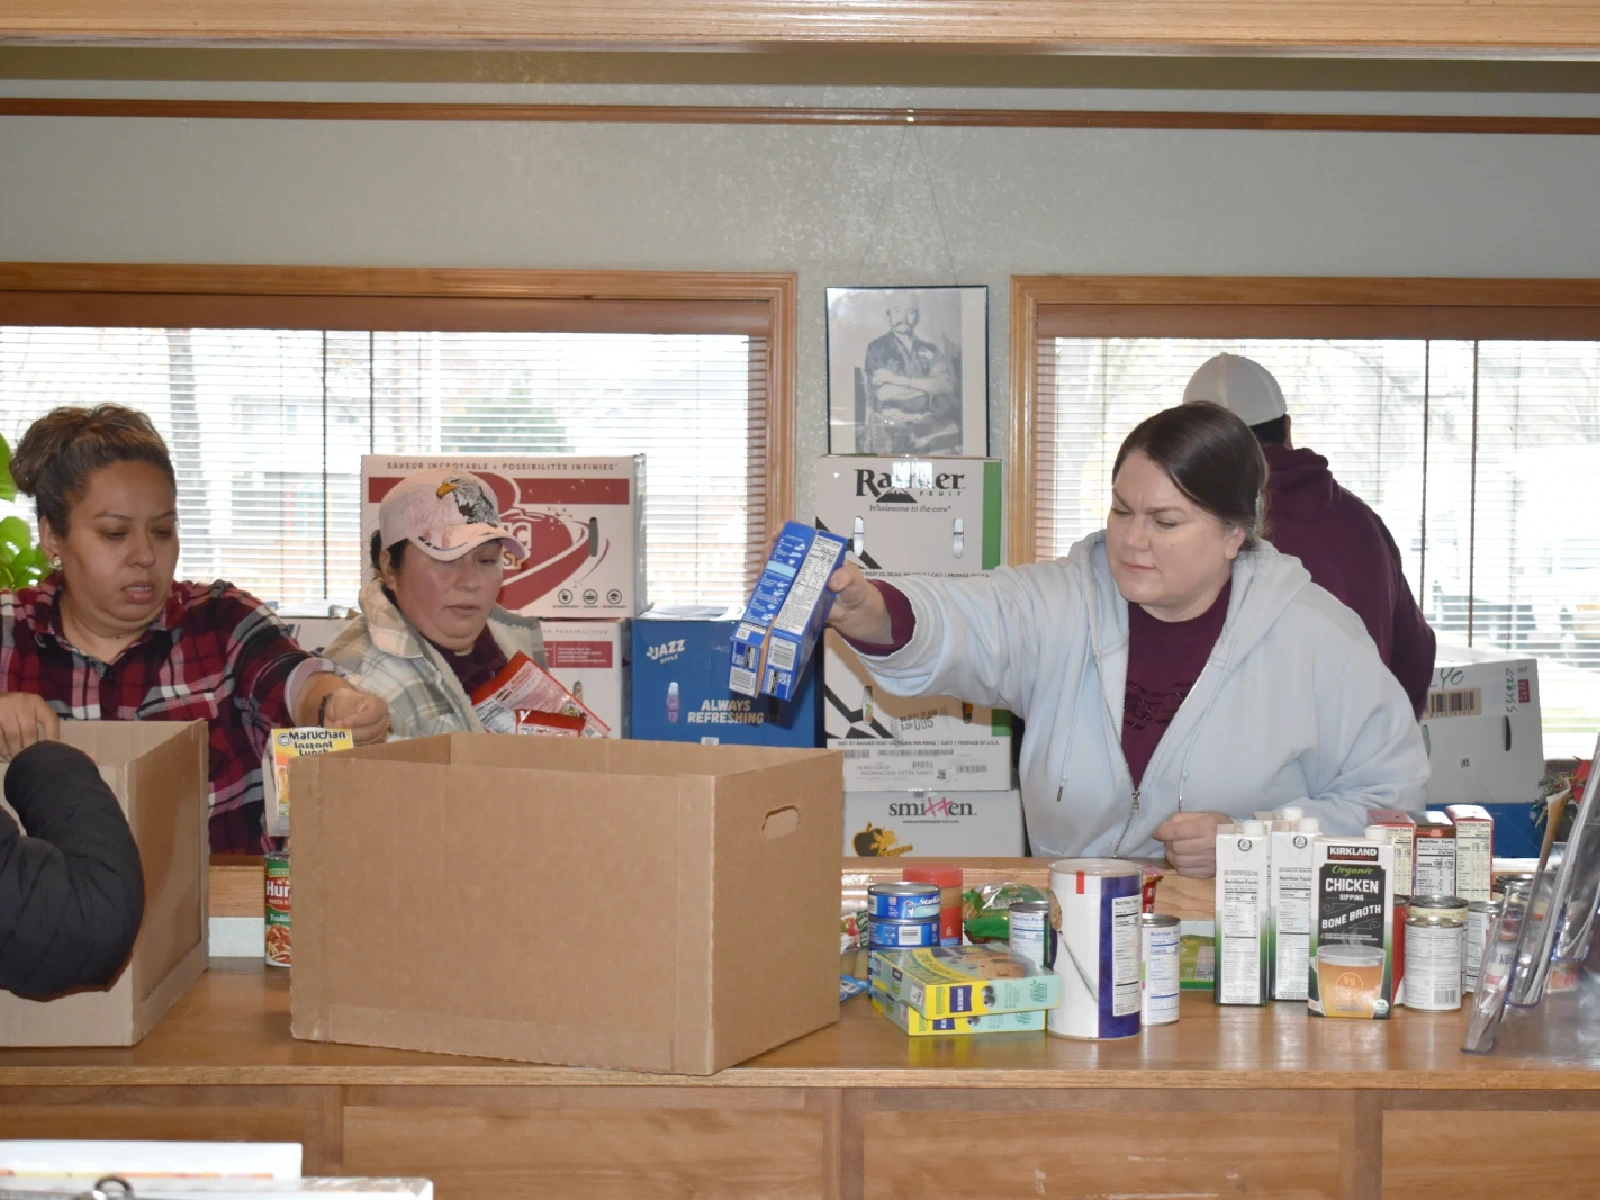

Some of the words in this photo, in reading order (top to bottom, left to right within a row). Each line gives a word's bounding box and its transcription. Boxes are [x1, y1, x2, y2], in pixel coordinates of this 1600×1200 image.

[855, 469, 966, 498] Raer
[869, 504, 910, 513] Wholesome
[911, 505, 919, 513] to
[919, 504, 932, 513] the
[646, 639, 686, 660] JAZZ
[660, 654, 679, 664] APPLE
[701, 699, 751, 711] ALWAYS
[687, 711, 765, 723] REFRESHING
[288, 730, 346, 740] Maruchan
[294, 741, 333, 749] Instant
[888, 796, 975, 818] smitten
[1329, 846, 1378, 856] KIRKLAND
[1332, 865, 1374, 877] Organic
[1325, 877, 1379, 894] CHICKEN
[1339, 893, 1364, 901] SIPPING
[1322, 913, 1347, 929] BONE
[1349, 904, 1381, 922] BROTH
